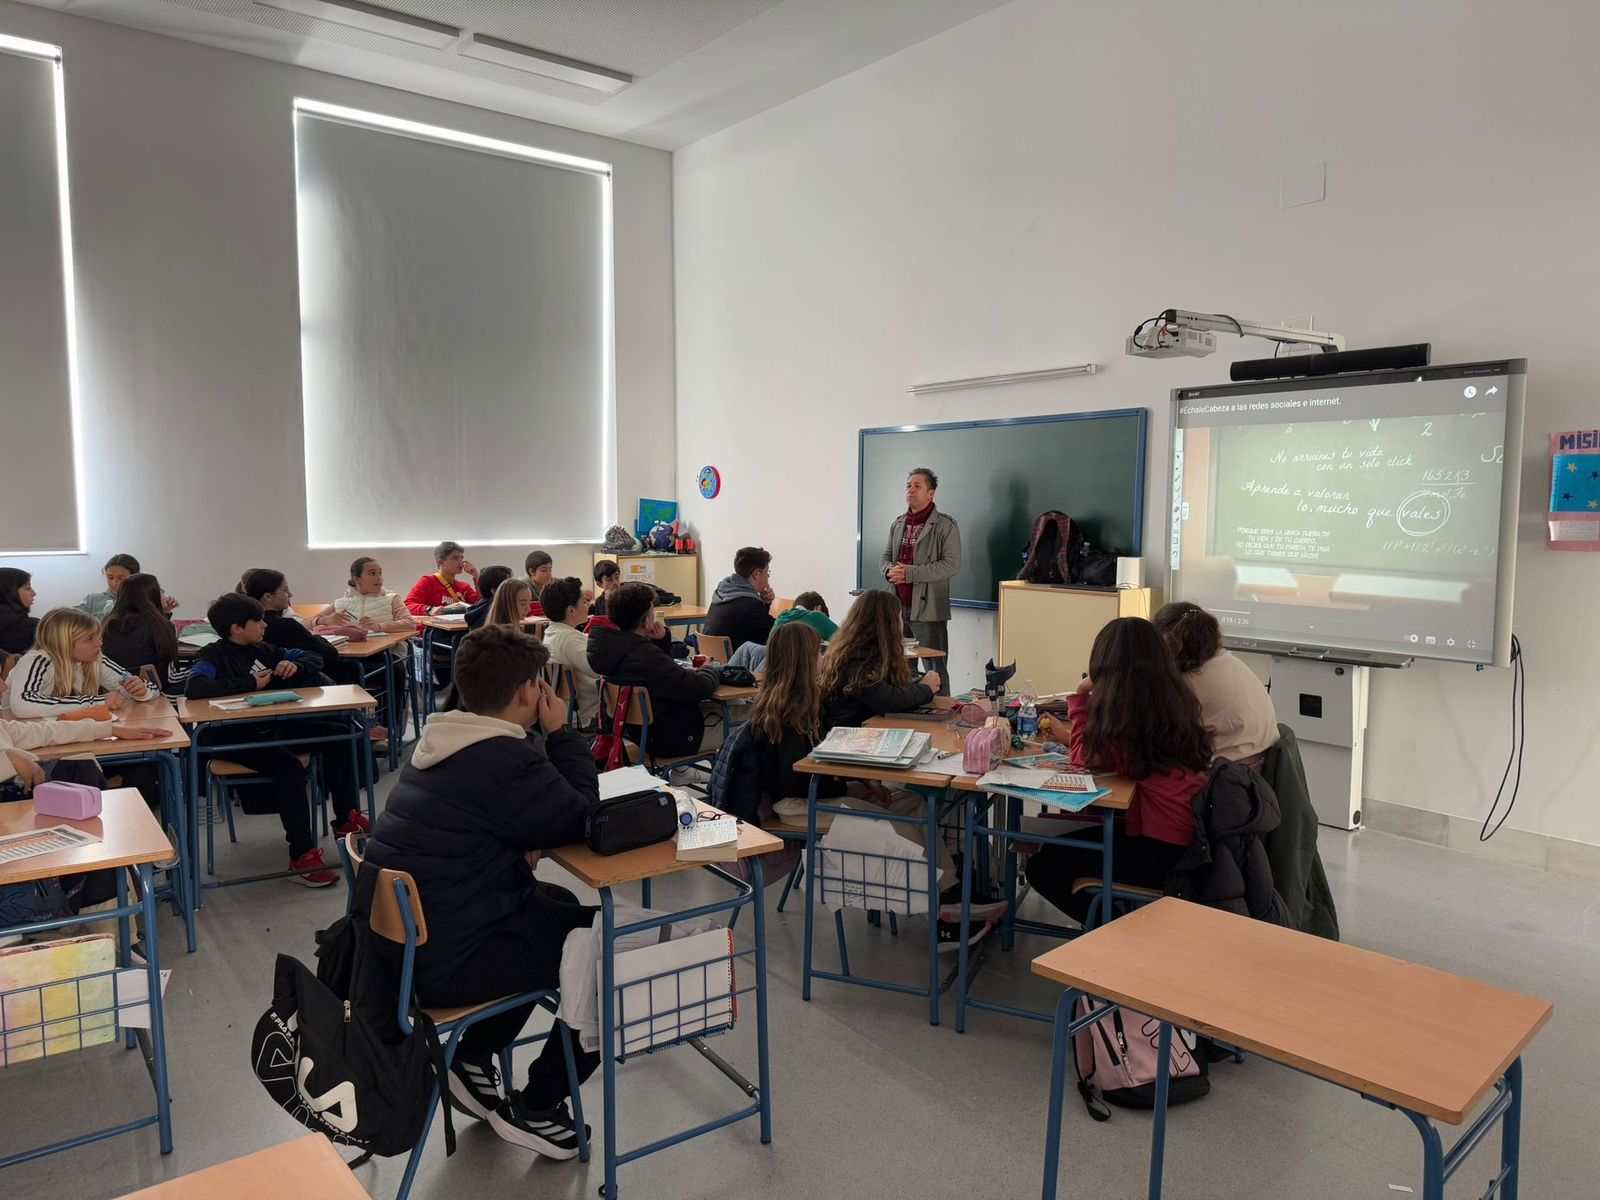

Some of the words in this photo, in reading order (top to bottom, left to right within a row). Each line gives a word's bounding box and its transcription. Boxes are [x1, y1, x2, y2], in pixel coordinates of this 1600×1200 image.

[1236, 402, 1248, 411] las
[1248, 401, 1269, 410] redes
[1270, 400, 1301, 409] sociales
[1270, 450, 1287, 463] No
[1342, 448, 1353, 458] tu
[1360, 445, 1384, 457] vida
[1316, 463, 1333, 471] con
[1360, 458, 1381, 468] solo
[1386, 454, 1415, 467] click
[1240, 480, 1290, 496] Aprende
[1308, 488, 1350, 500] valorar
[1316, 503, 1358, 515] mucho
[1366, 507, 1393, 528] que
[1402, 505, 1441, 520] vales
[273, 1017, 288, 1033] FILA
